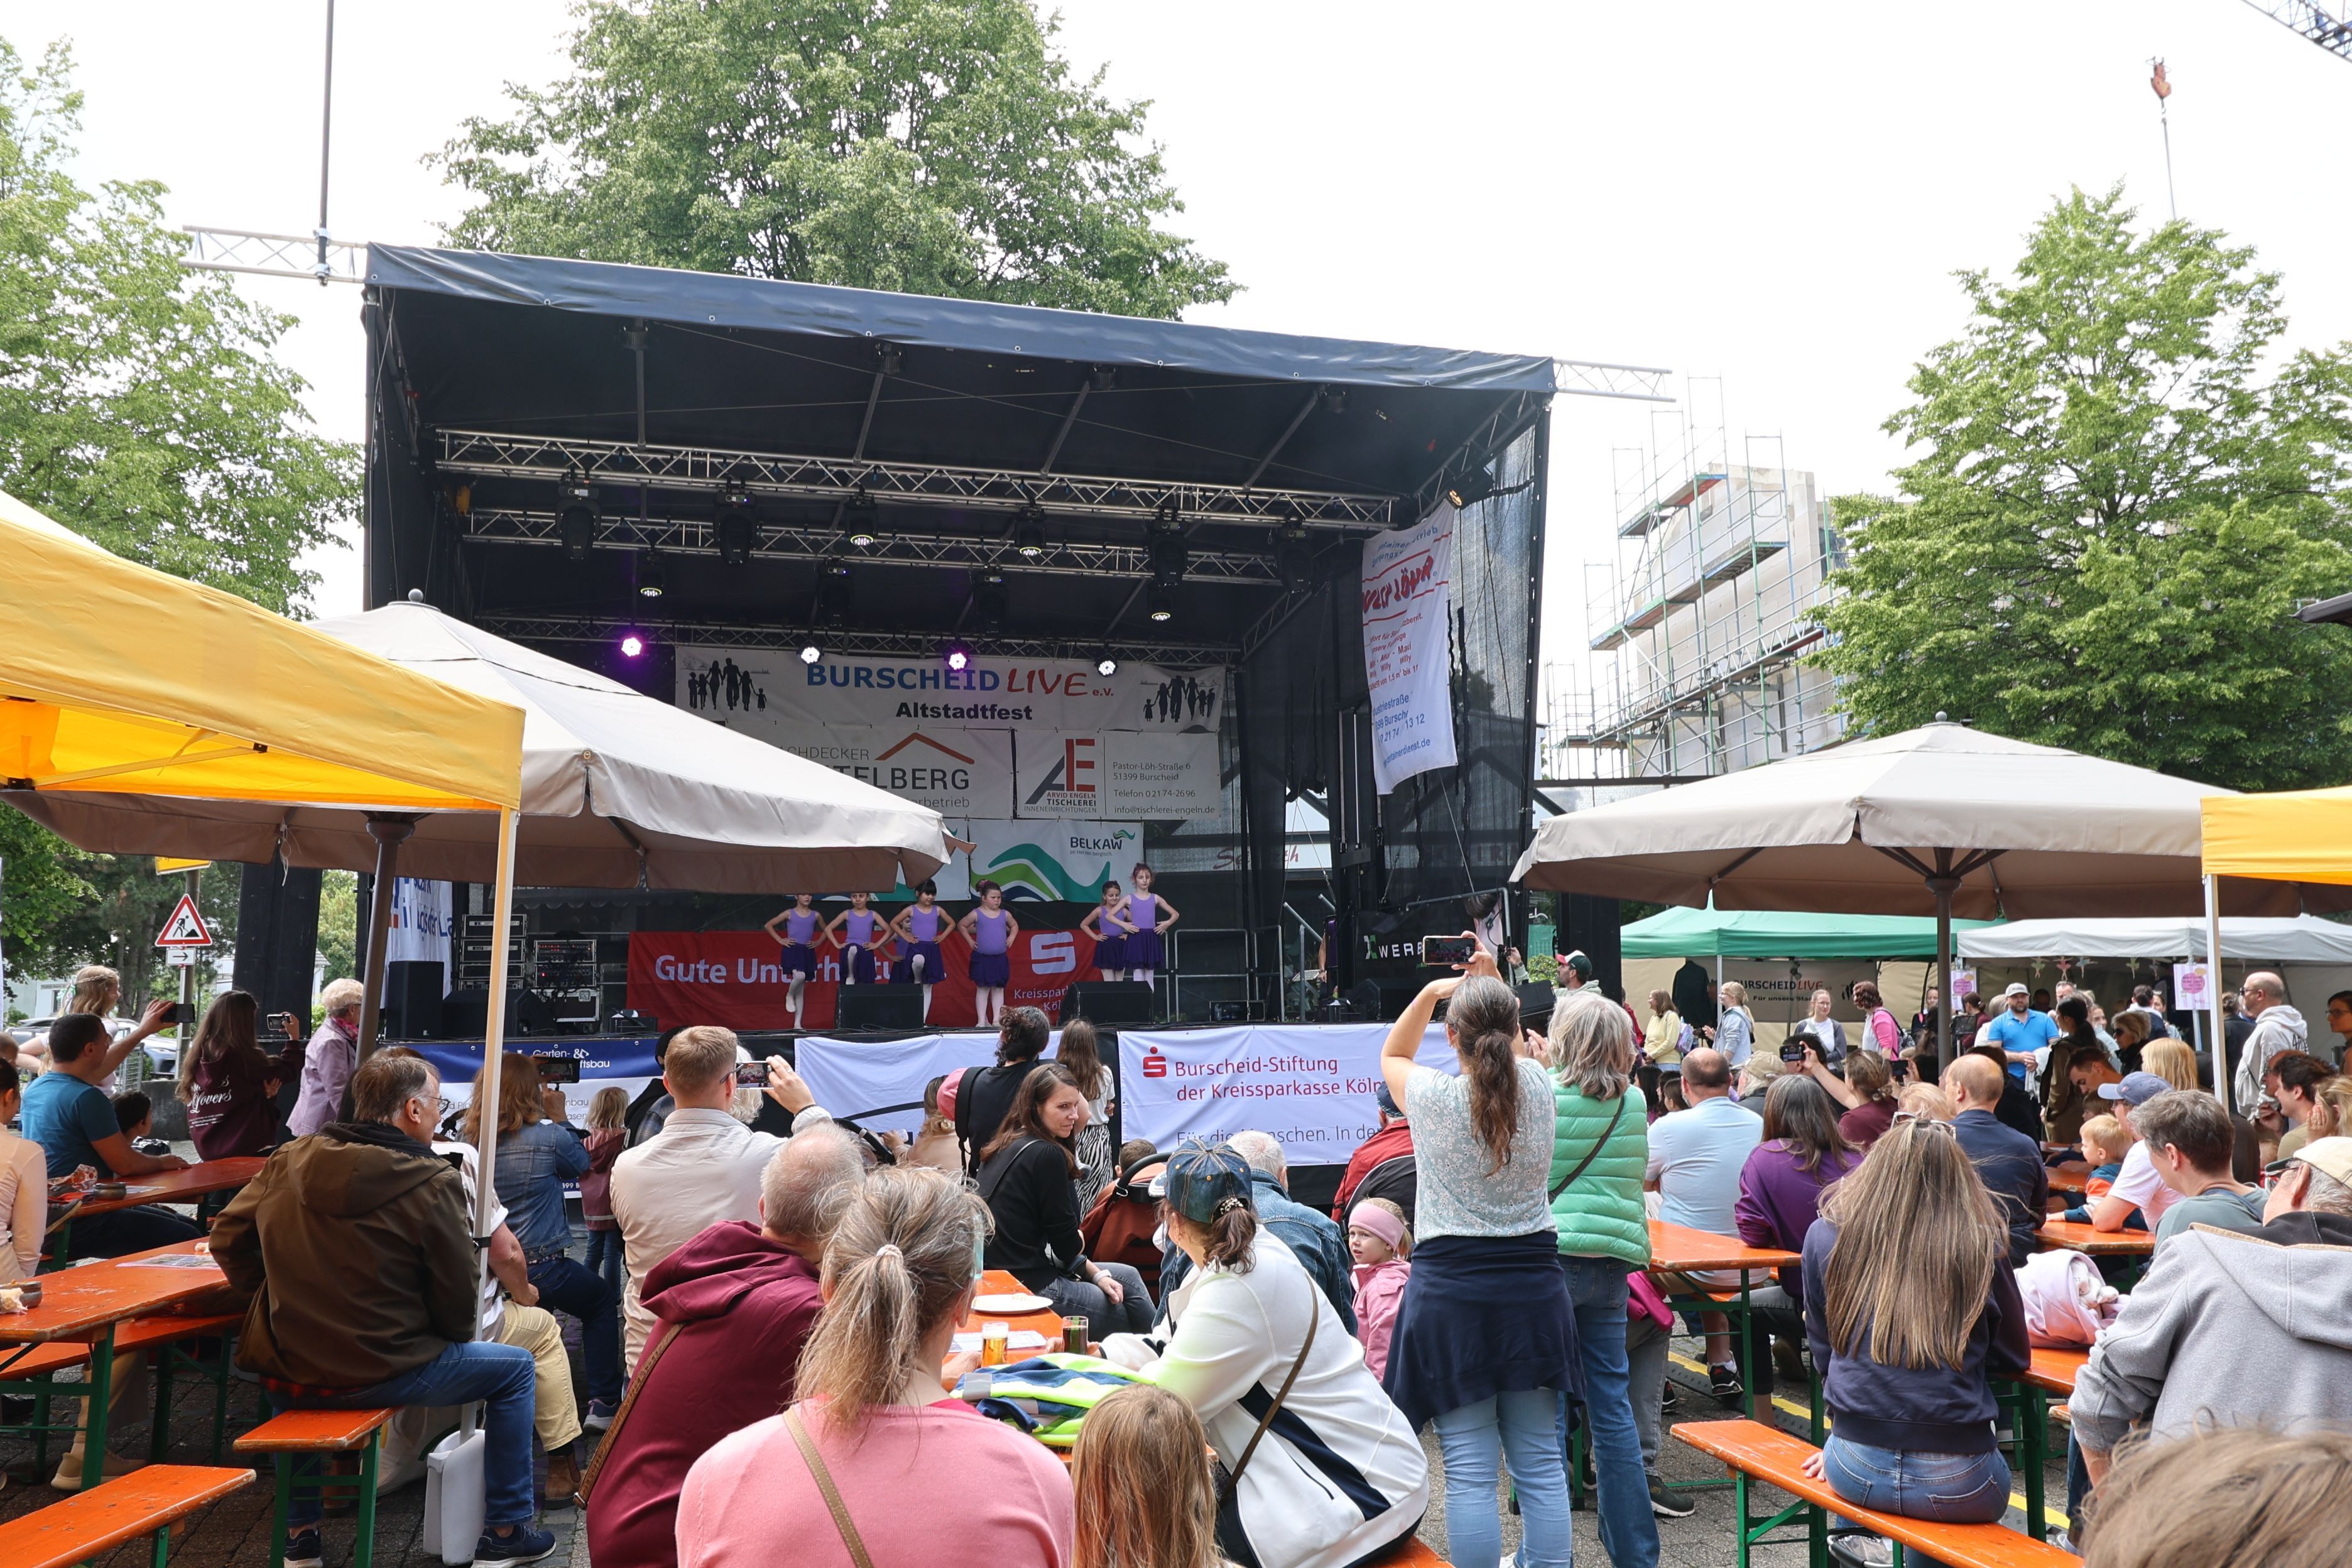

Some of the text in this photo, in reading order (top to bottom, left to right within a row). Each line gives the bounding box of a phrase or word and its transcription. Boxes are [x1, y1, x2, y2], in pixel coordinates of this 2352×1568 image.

[807, 665, 1114, 697] BURSCHEID LIVE e.V.
[895, 701, 1033, 721] Altstadtfest
[1416, 713, 1425, 725] 12
[1113, 761, 1184, 771] Pastor-Löh-Straße
[833, 765, 970, 790] TELBERG
[1140, 773, 1179, 781] Burscheid
[1113, 790, 1143, 798] Telefon
[1047, 798, 1096, 807] TISCHLEREI
[1024, 805, 1097, 814] INNENEINRICHTUNGEN
[1114, 805, 1215, 815] info@tischlerei-engeln.de
[1070, 837, 1123, 850] BELKAW
[655, 954, 727, 984] Gute
[1798, 980, 1824, 991] LIVE
[1043, 1000, 1061, 1011] Köl
[580, 1060, 610, 1068] ftsbau
[1175, 1056, 1338, 1077] Burscheid-Stiftung
[1177, 1085, 1206, 1101] der
[1212, 1079, 1340, 1100] Kreissparkasse
[1336, 1125, 1350, 1141] In
